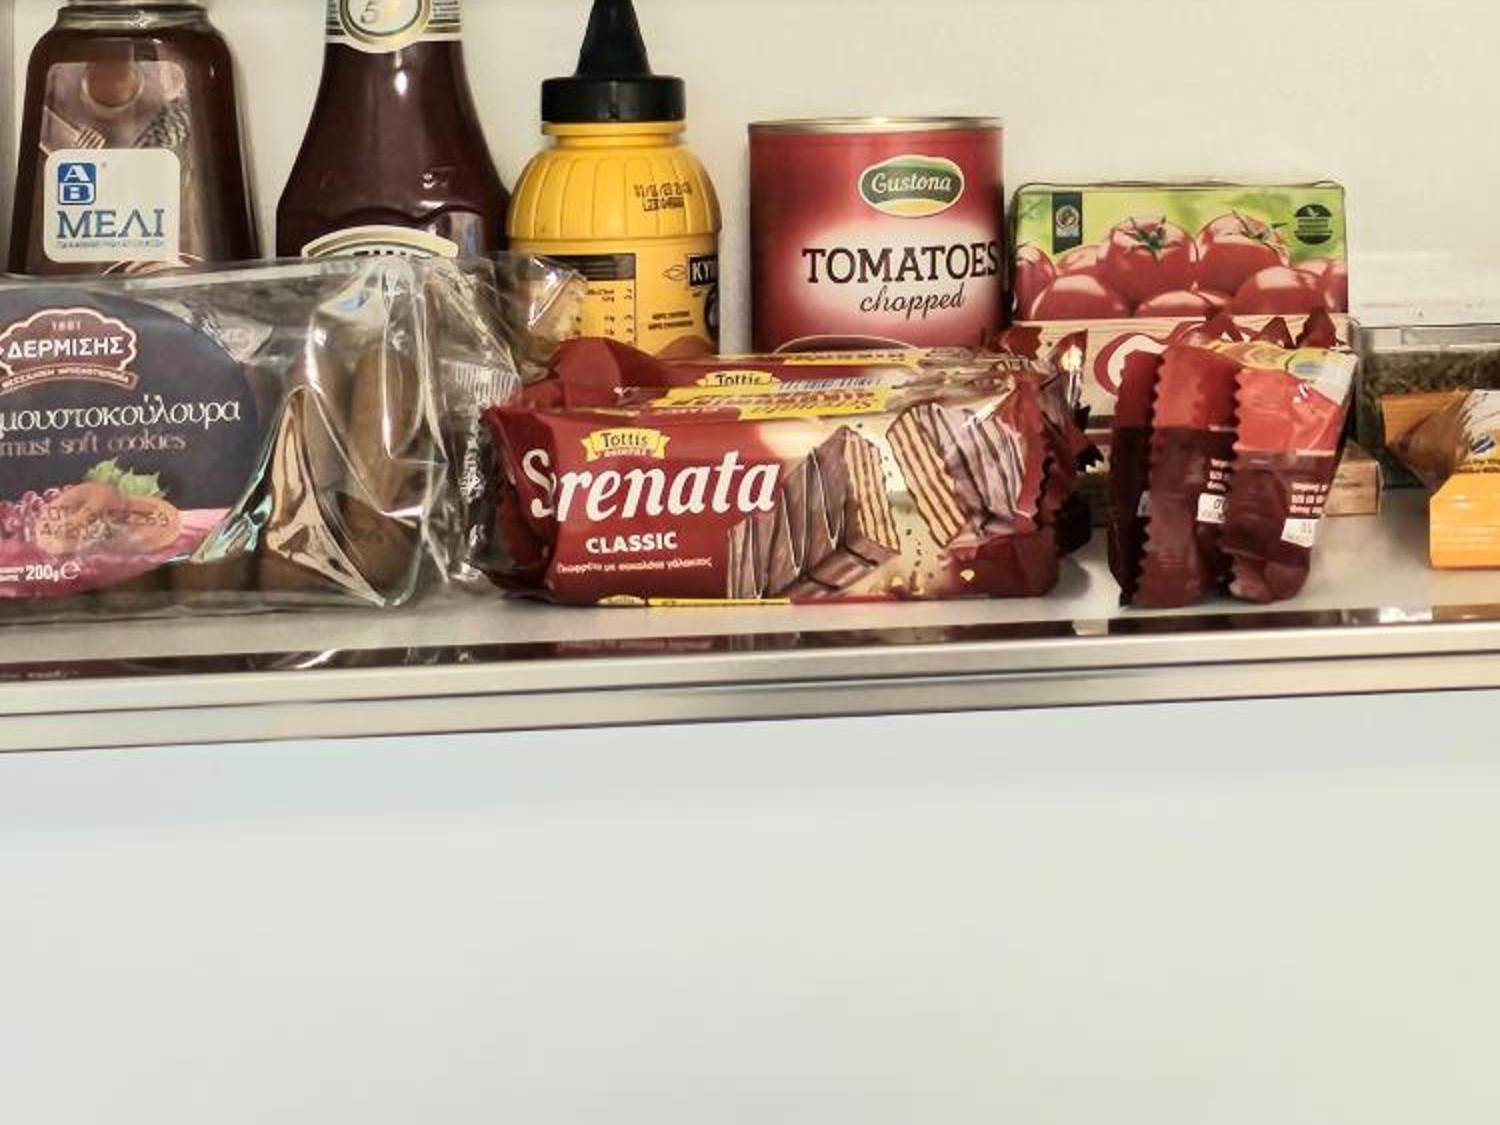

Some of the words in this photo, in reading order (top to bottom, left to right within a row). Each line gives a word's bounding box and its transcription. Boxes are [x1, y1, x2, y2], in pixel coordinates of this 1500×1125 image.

[871, 172, 952, 194] Gustona
[56, 209, 165, 239] ΜΕΛΙ
[801, 239, 998, 284] TOMATOES
[859, 282, 966, 320] chopped
[7, 336, 125, 359] ΔΕΡΜΙΣΗΣ
[60, 430, 98, 454] soft
[107, 429, 188, 453] cookies
[600, 432, 649, 448] Tottis
[585, 531, 677, 554] CLASSIC
